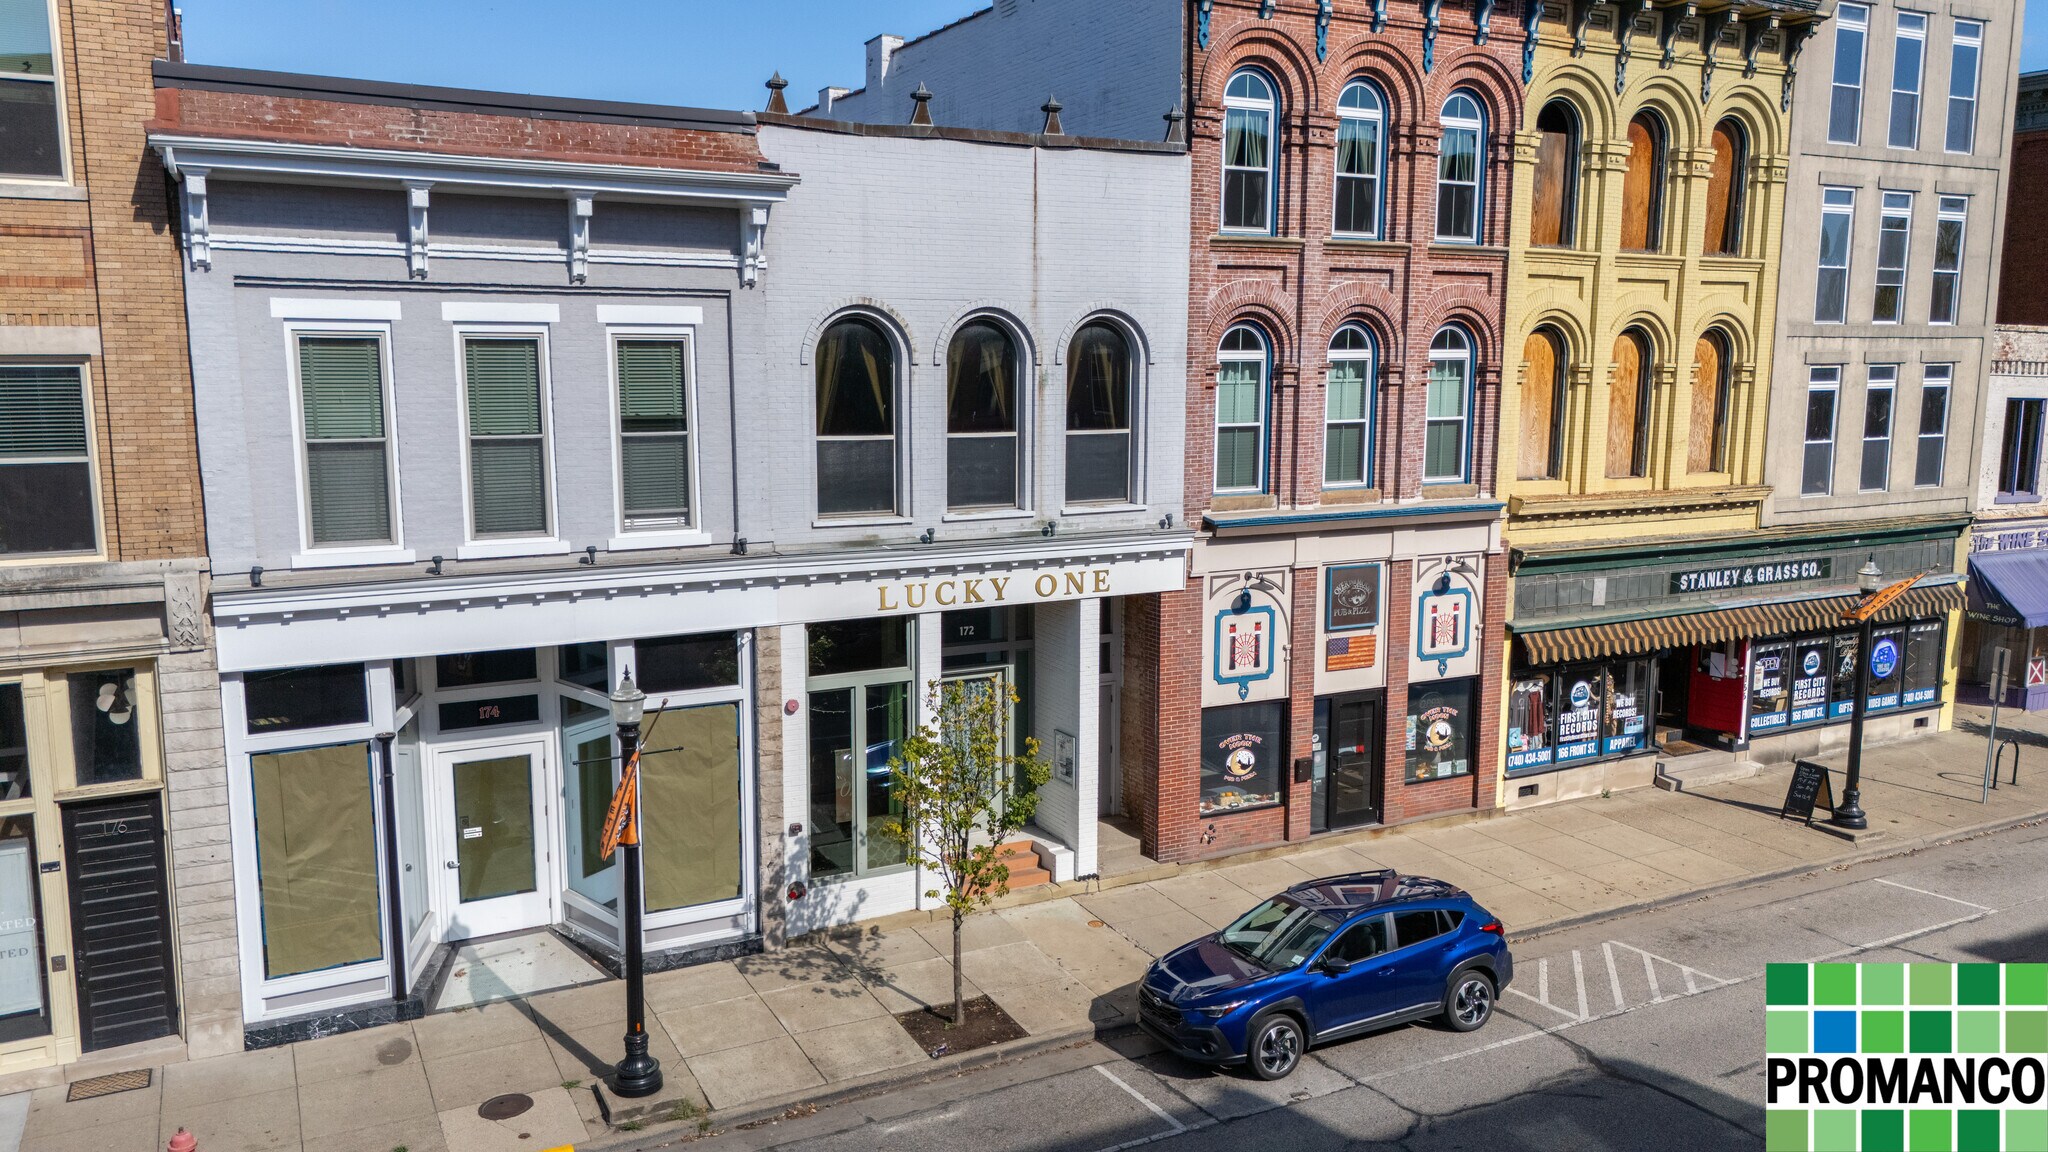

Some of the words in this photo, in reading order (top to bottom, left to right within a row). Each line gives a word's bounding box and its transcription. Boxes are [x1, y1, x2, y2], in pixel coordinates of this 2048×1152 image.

[1998, 531, 2035, 551] WINE
[1680, 570, 1739, 590] STANLEY
[1743, 569, 1754, 583] &
[1757, 563, 1798, 582] GRASS
[1801, 562, 1822, 577] CO.
[877, 576, 1010, 611] LUCKY
[1034, 569, 1111, 597] ONE
[1333, 608, 1347, 617] PUB
[1985, 602, 2000, 610] THE
[1968, 611, 1991, 621] WINE
[1992, 614, 2018, 624] SHOP
[959, 625, 975, 636] 172
[1794, 680, 1811, 690] FIRST
[1812, 676, 1827, 687] CITY
[1793, 686, 1826, 701] RECORDS
[1881, 694, 1897, 706] GAMES
[479, 705, 500, 719] 174
[1420, 707, 1441, 721] OVER
[1441, 706, 1459, 717] THE
[1612, 707, 1637, 719] RECORDS!
[1792, 710, 1801, 721] 166
[1801, 708, 1817, 719] FRONT
[1816, 706, 1825, 718] ST.
[1838, 702, 1854, 714] GIFTS
[1560, 712, 1580, 725] FIRST
[1582, 708, 1599, 721] CITY
[1750, 713, 1787, 729] COLLECTIBLES
[1560, 720, 1598, 735] RECORDS
[1219, 734, 1242, 749] OVER
[1243, 733, 1263, 744] THE
[1609, 737, 1636, 751] APPAREL
[1557, 746, 1569, 759] 166
[1569, 743, 1587, 757] FRONT
[1586, 742, 1597, 755] ST.
[1508, 754, 1524, 767] (740)
[1524, 751, 1551, 764] 434-5001
[102, 819, 128, 837] 176
